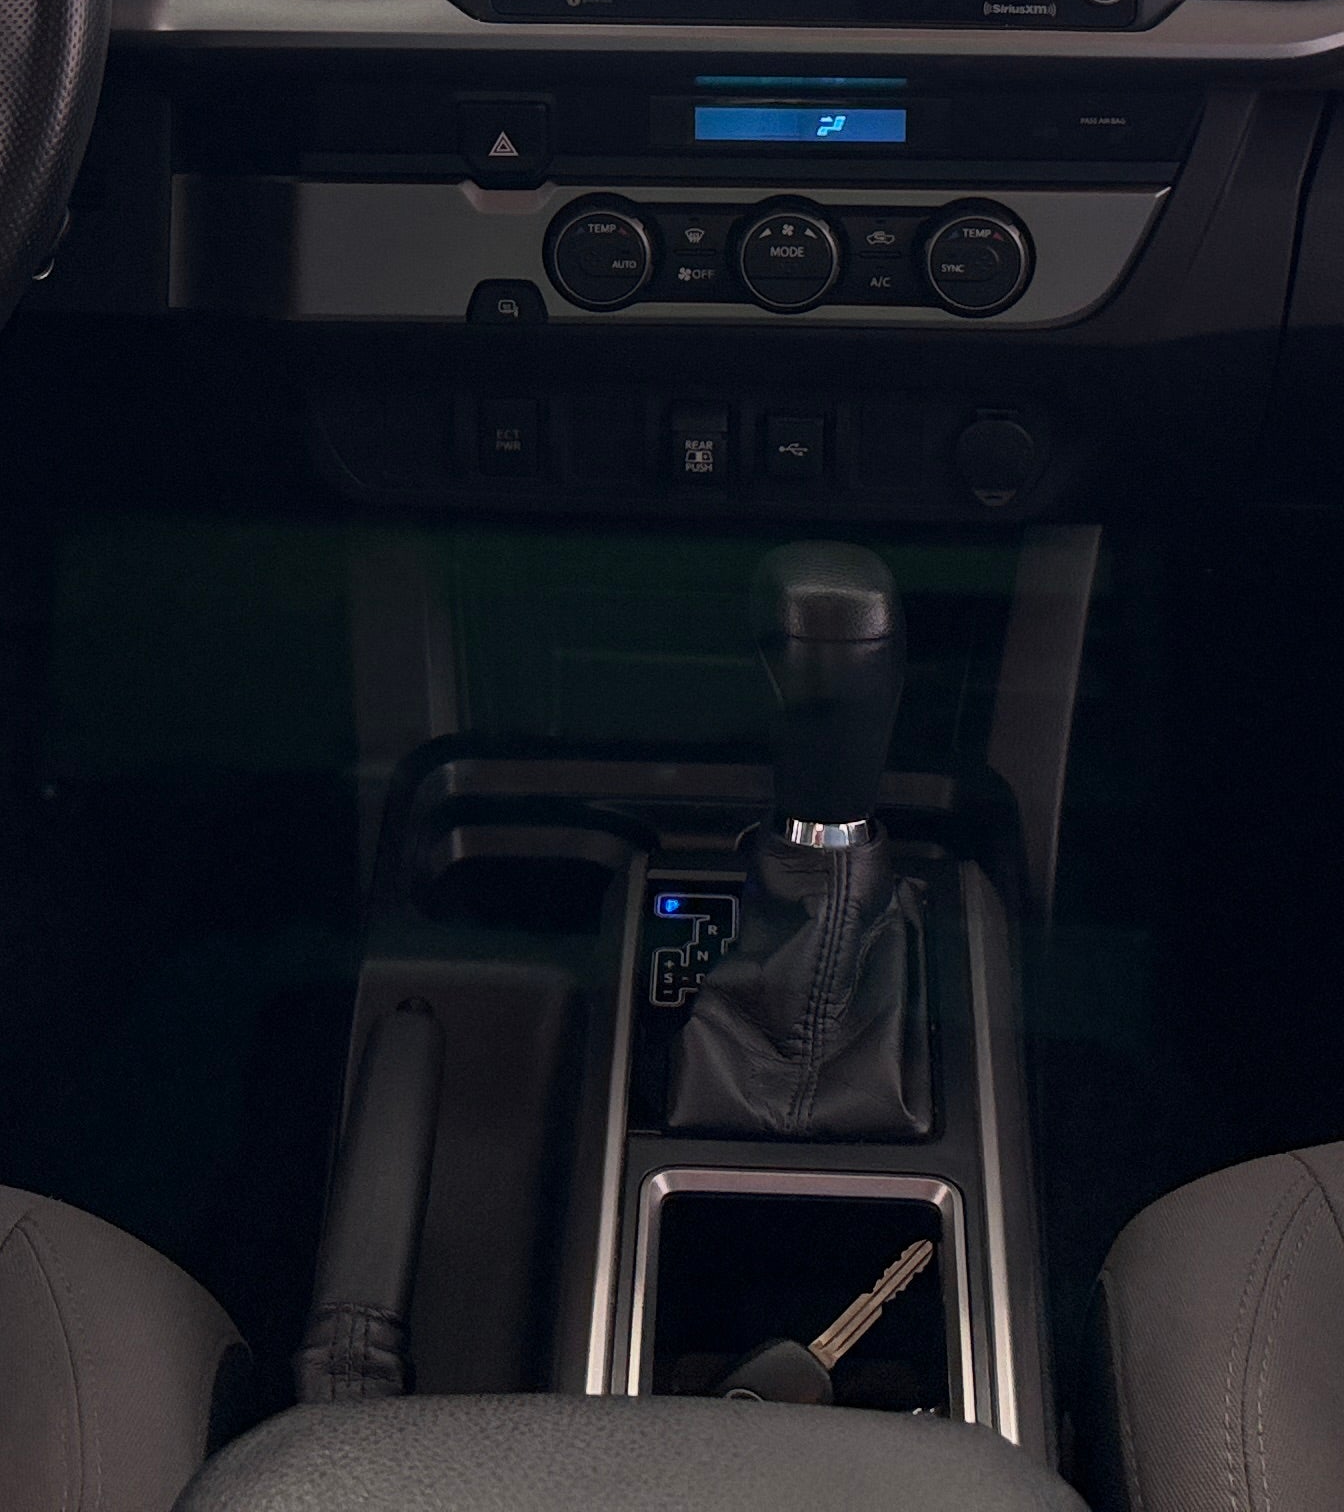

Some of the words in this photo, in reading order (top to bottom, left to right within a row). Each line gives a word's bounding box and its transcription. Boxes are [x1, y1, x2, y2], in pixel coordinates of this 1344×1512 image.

[587, 223, 618, 235] TEMP
[962, 228, 992, 240] TEMP
[770, 246, 805, 258] MODE
[612, 259, 637, 270] AUTO
[940, 263, 965, 274] SYNC
[691, 269, 715, 281] OFF
[869, 276, 891, 288] A/C
[495, 440, 521, 452] PWR
[684, 439, 714, 451] REAR
[685, 462, 714, 473] PUSH
[707, 924, 719, 936] R
[697, 950, 709, 962] N
[663, 972, 674, 984] S
